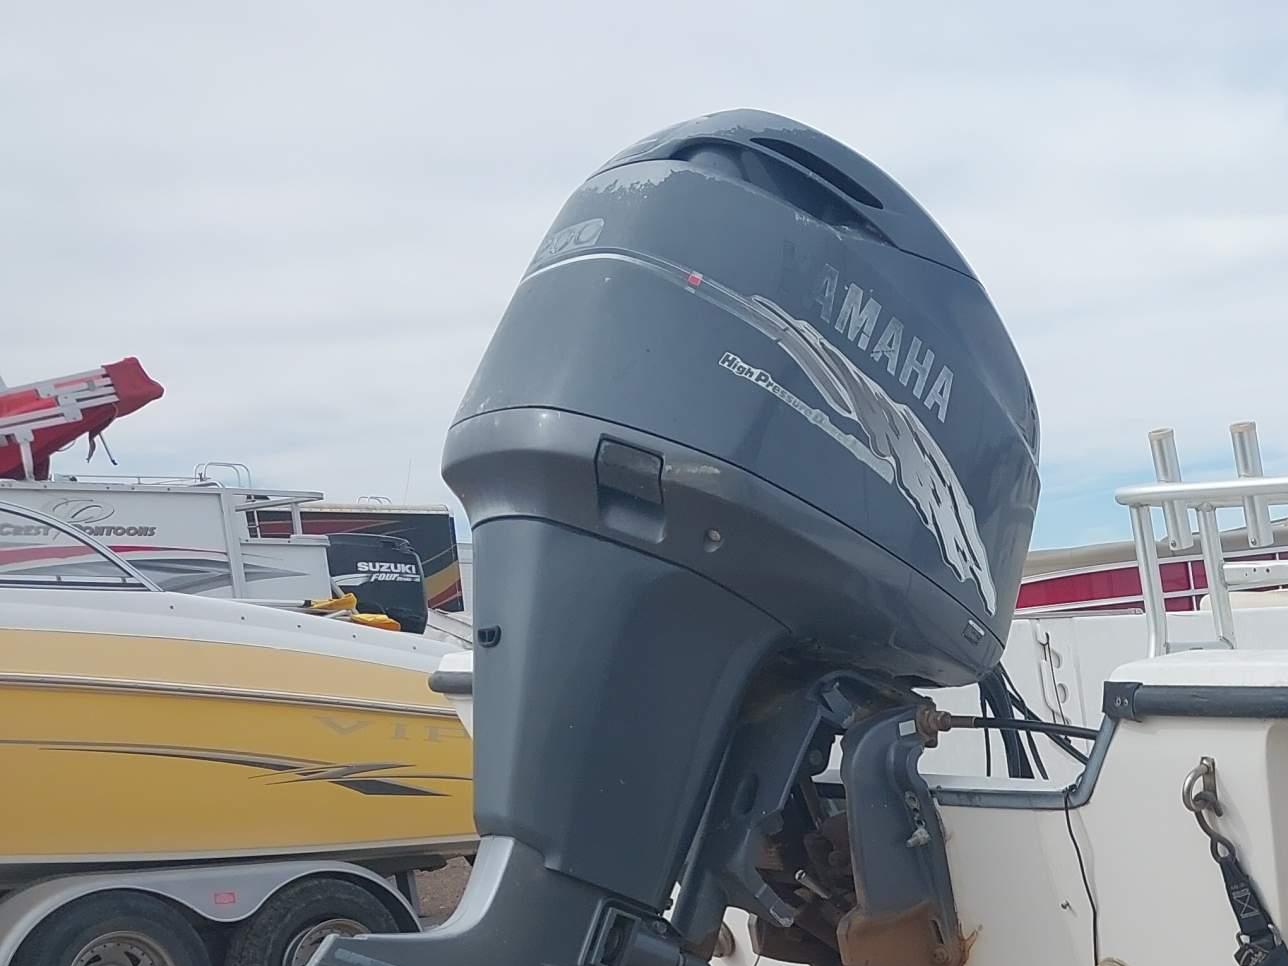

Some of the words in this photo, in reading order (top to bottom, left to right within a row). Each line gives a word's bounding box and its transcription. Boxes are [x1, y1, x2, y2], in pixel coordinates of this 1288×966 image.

[802, 252, 954, 423] AMAHA
[720, 353, 755, 378] High
[356, 561, 417, 574] SUZUKI
